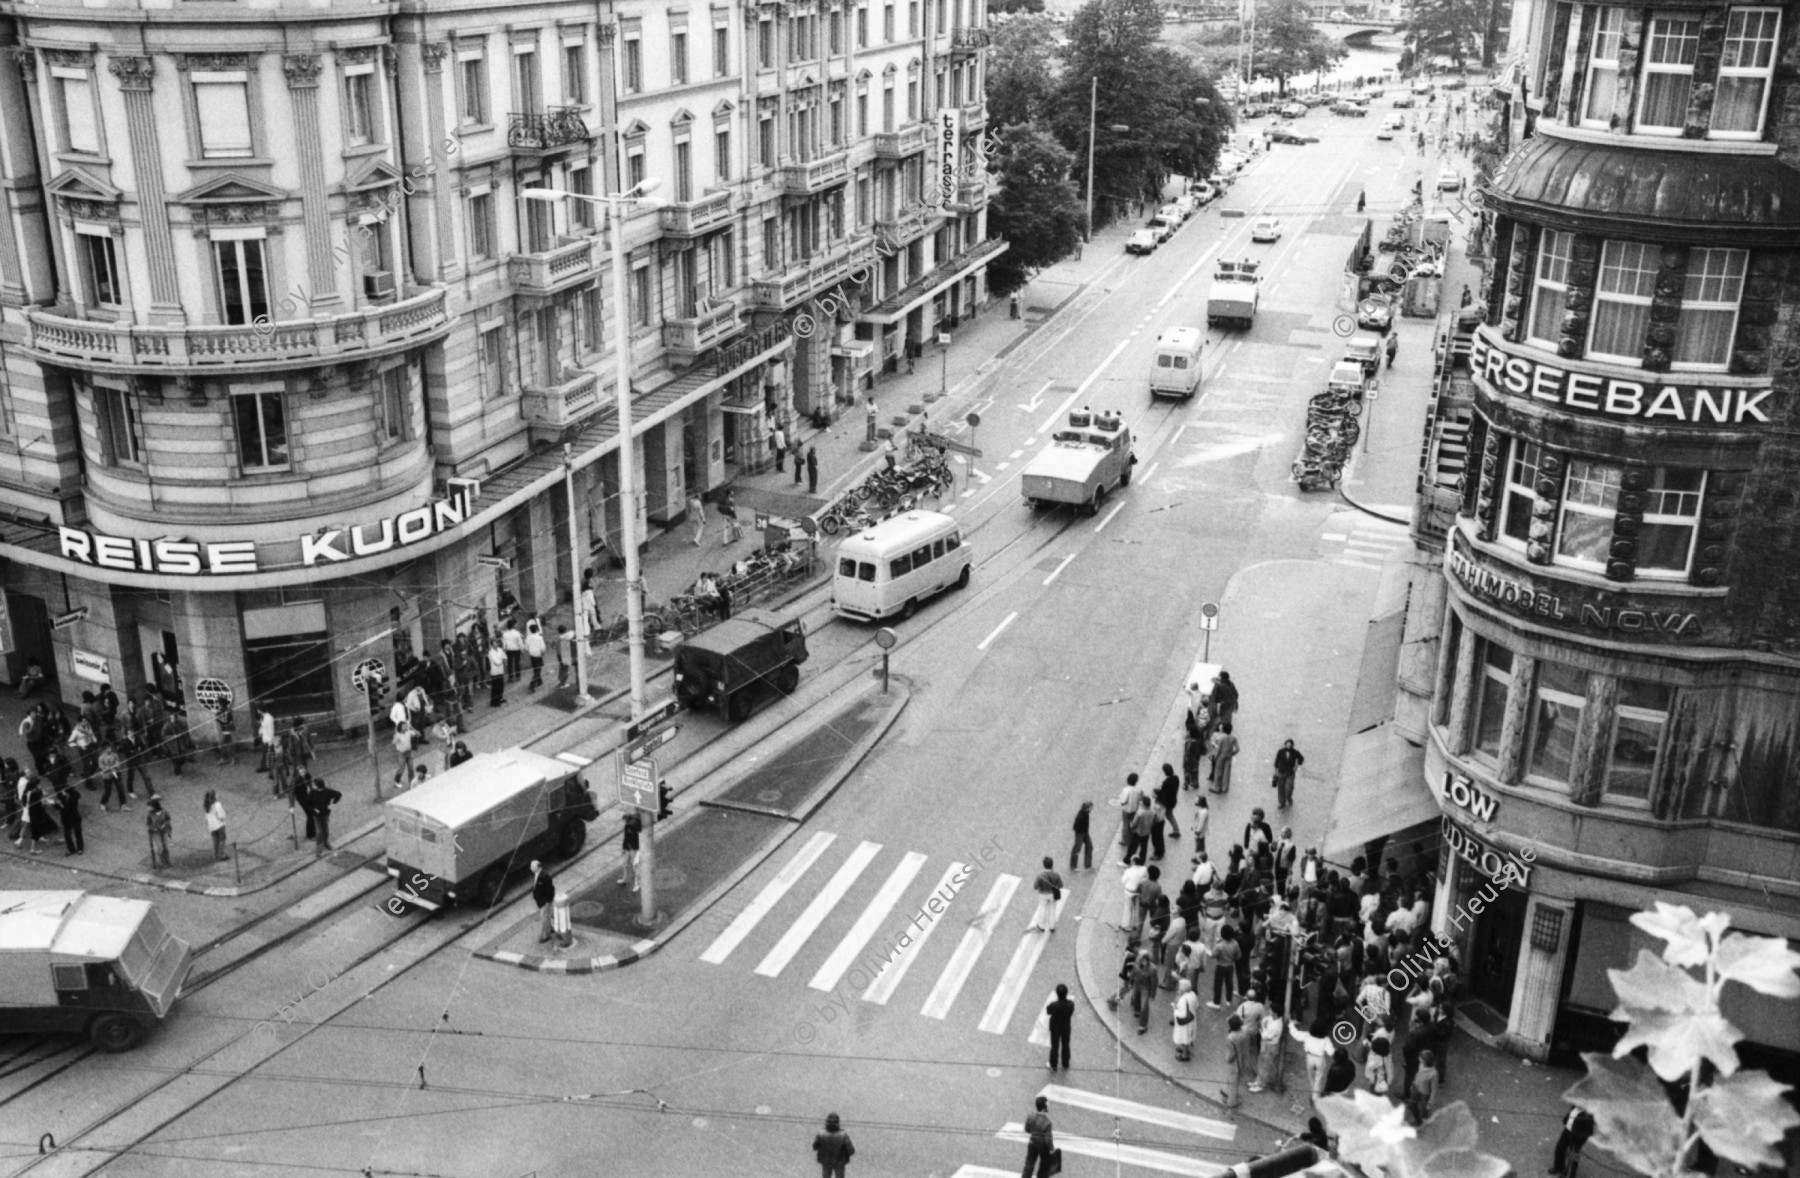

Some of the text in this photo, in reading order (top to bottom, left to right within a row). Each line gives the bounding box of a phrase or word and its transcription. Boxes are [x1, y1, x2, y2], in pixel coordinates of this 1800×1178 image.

[58, 488, 471, 575] REISE KUONI
[1580, 604, 1704, 634] NOVA
[1441, 813, 1532, 887] ODEON
